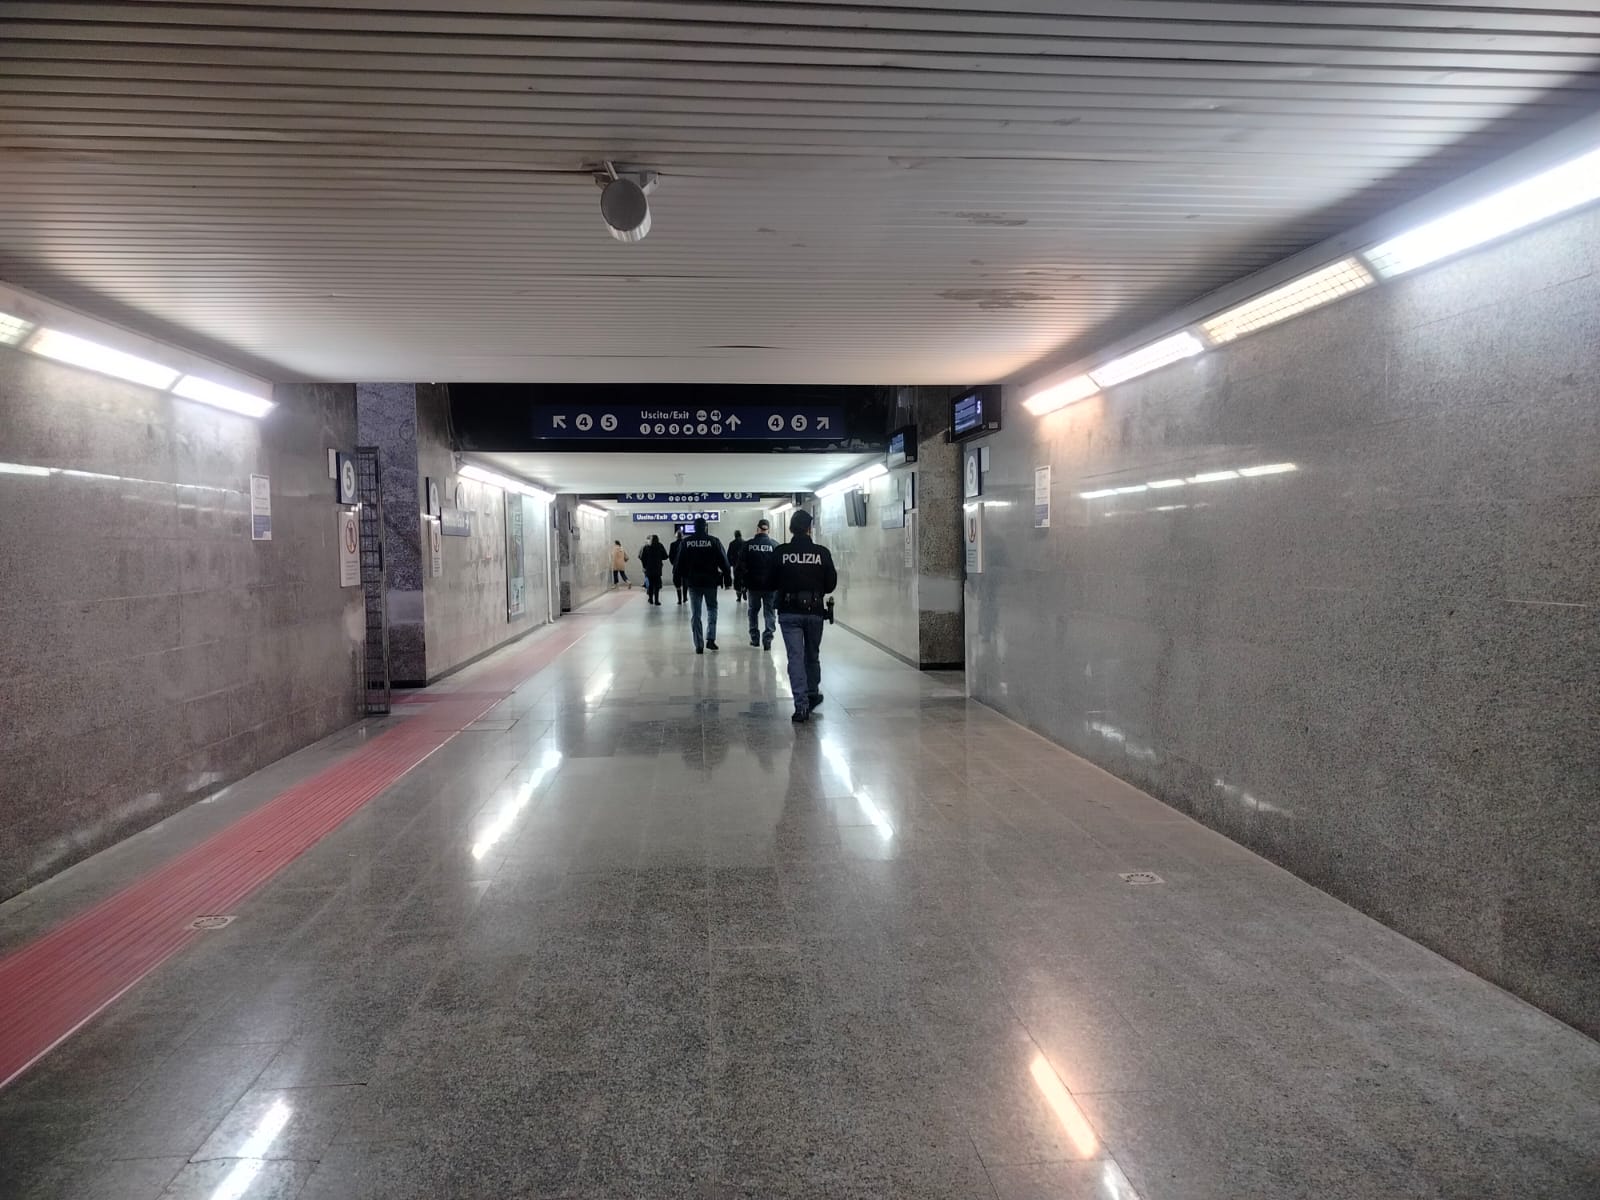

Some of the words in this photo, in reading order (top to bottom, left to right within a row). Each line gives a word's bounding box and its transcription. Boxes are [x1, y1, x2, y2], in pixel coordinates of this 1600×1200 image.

[640, 410, 690, 420] Uscita/Exit
[686, 539, 712, 548] POLIZIA
[748, 544, 774, 553] POLIZIA
[782, 552, 822, 566] POLIZIA
